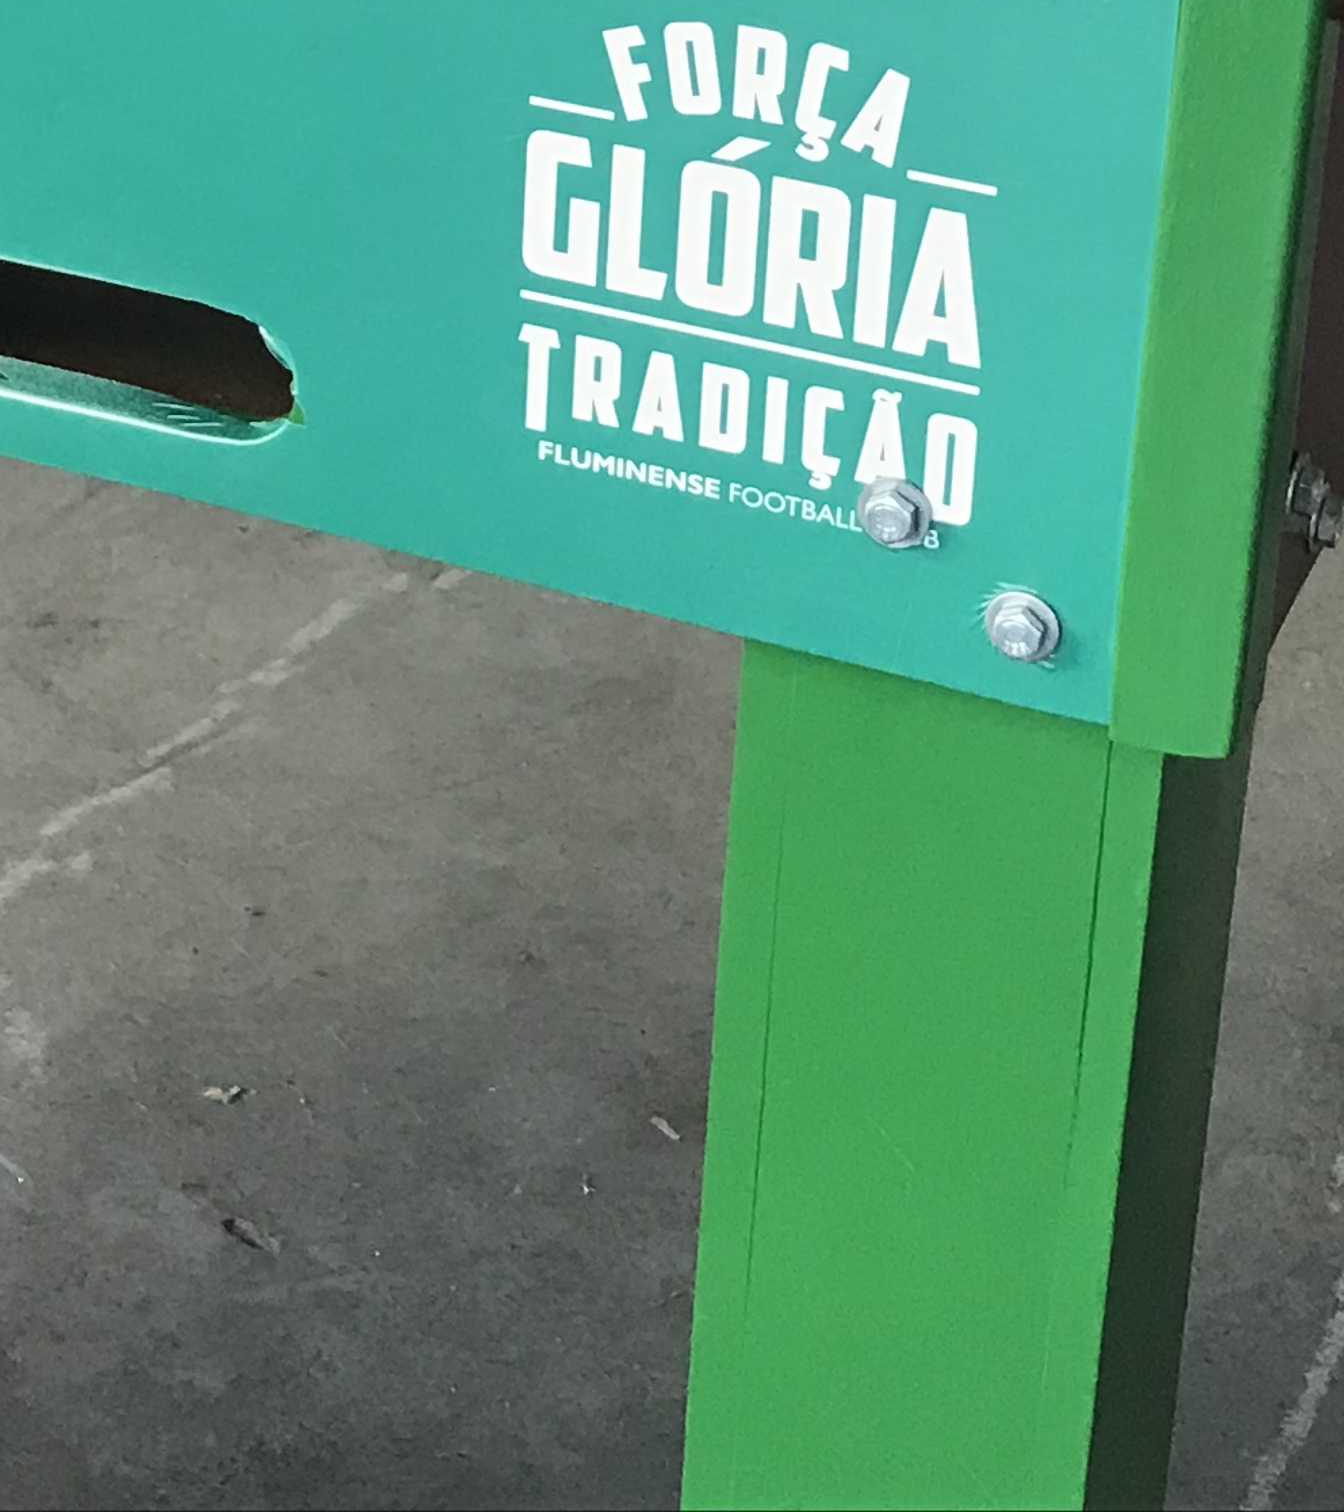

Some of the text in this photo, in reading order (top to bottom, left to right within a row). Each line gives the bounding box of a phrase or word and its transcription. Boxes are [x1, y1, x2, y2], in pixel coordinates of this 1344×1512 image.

[602, 21, 910, 168] FORÇA
[522, 129, 981, 368] GLÓRIA
[518, 323, 978, 526] TRADIÇÃO
[538, 440, 863, 532] FLUMINENSE FOOTBALL
